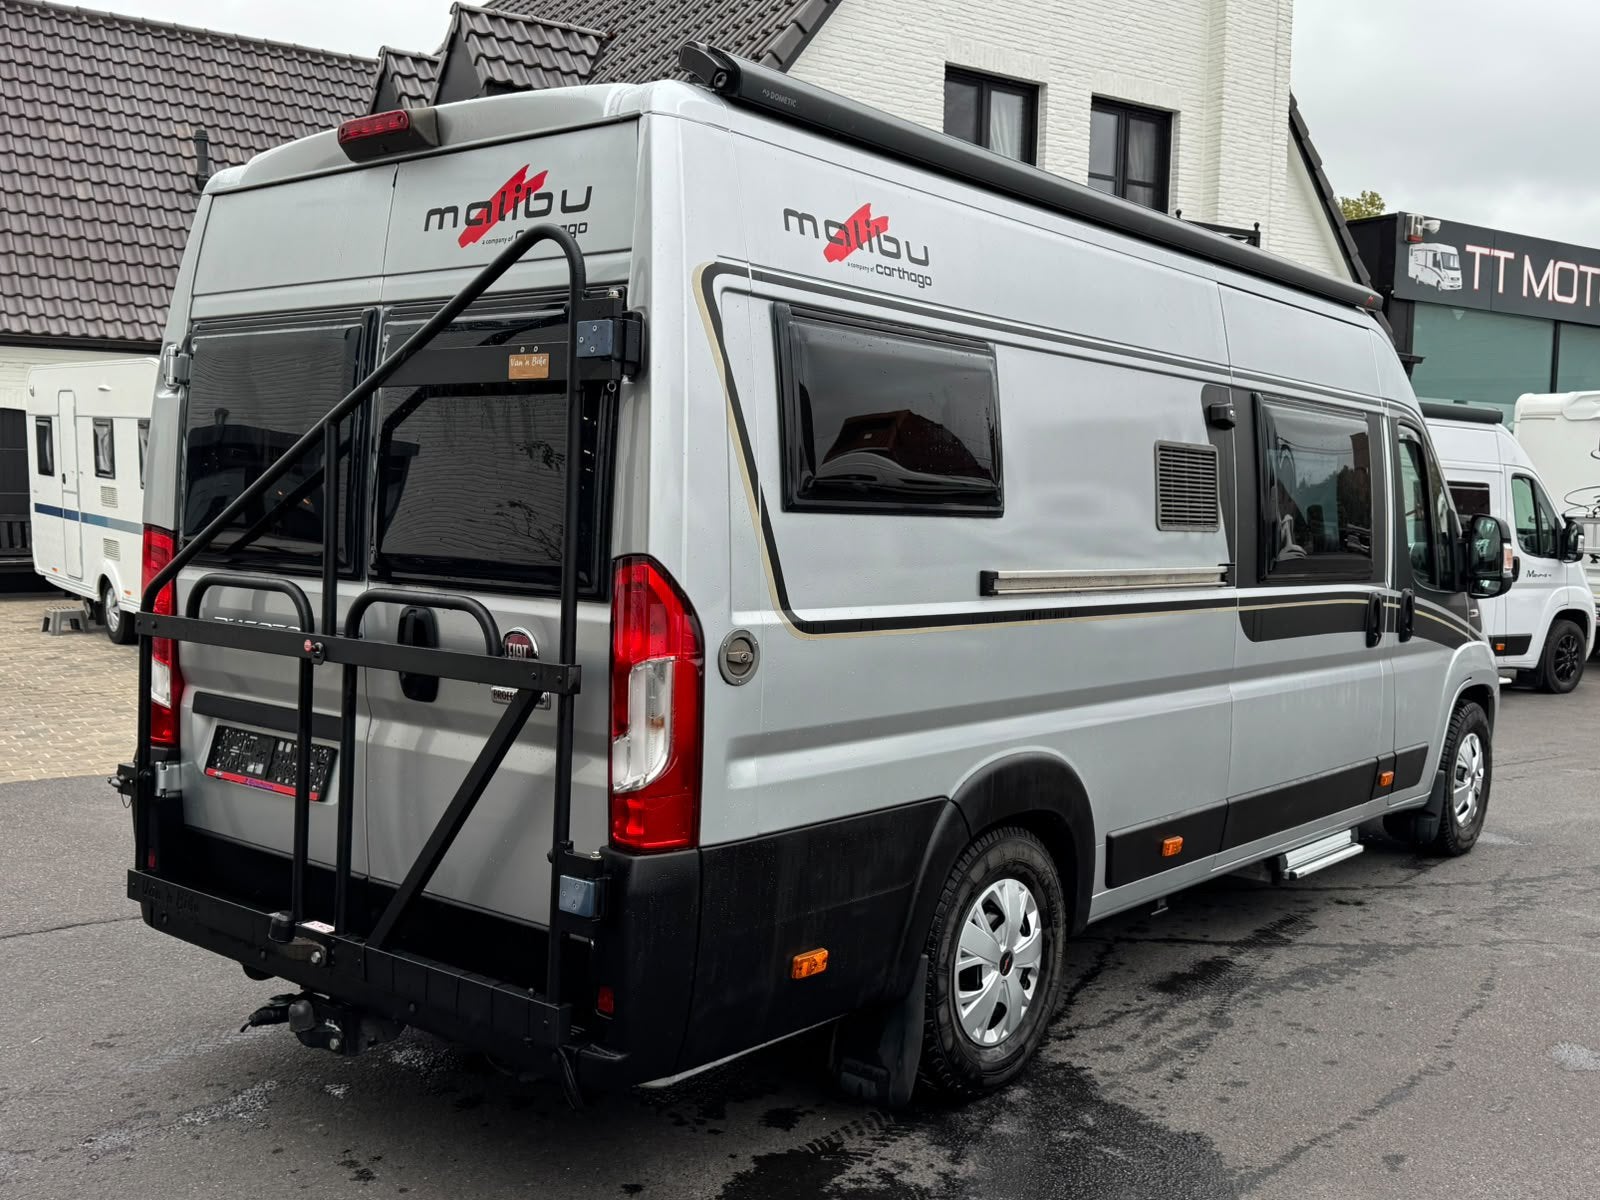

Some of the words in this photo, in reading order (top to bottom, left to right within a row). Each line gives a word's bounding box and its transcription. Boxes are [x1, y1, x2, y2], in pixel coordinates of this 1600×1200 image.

[770, 91, 796, 107] DOMETIC
[424, 184, 593, 232] malibu
[486, 236, 507, 245] company
[783, 208, 930, 267] malibu
[875, 264, 933, 289] carthago
[1465, 244, 1515, 294] TT
[1522, 254, 1600, 307] MOT
[507, 642, 529, 659] FIAT
